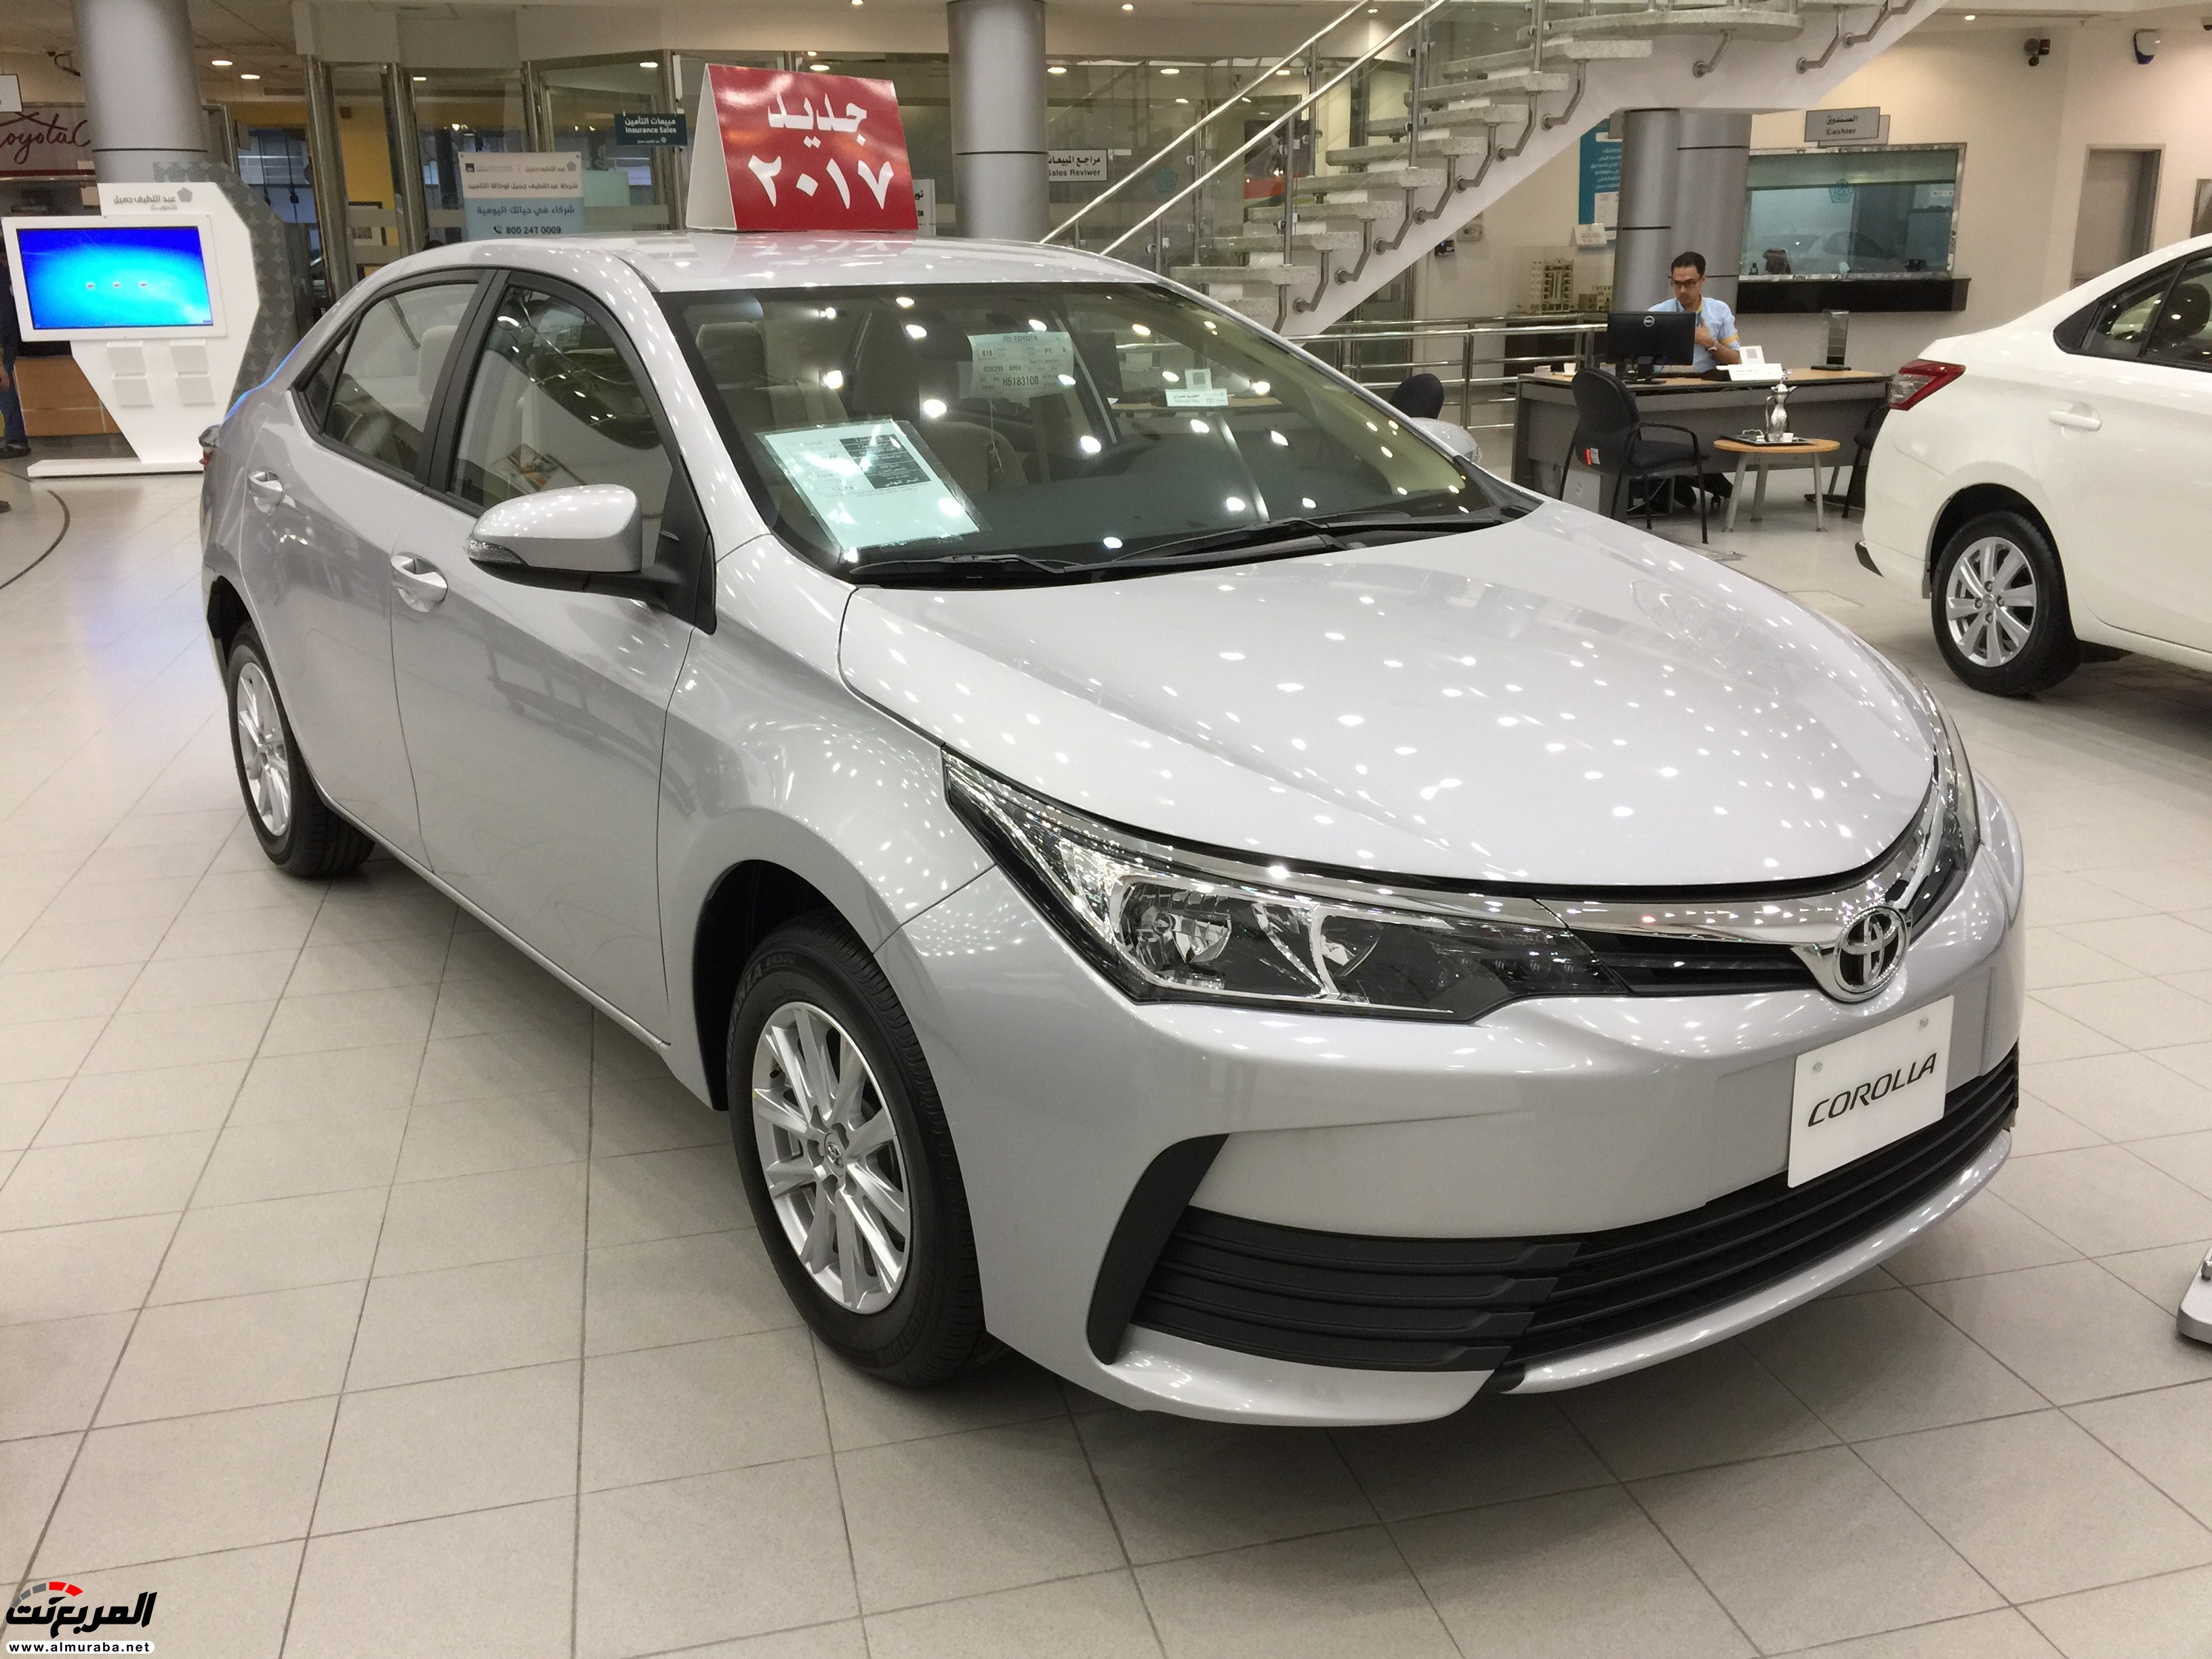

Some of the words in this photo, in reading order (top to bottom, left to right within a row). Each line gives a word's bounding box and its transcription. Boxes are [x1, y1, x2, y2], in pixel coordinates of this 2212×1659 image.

[651, 117, 676, 126] مبيعات
[768, 92, 867, 148] جديد
[1826, 115, 1858, 125] الصندوق
[1076, 156, 1101, 167] مراجع
[748, 155, 895, 209] ٢٠١٧
[114, 194, 132, 204] جميل
[134, 194, 161, 203] اللطيف
[476, 206, 507, 216] اليومية
[510, 206, 531, 216] حياتك
[534, 206, 548, 216] في
[552, 205, 575, 216] شركاء
[506, 226, 521, 234] 800
[541, 226, 561, 234] 0009
[1808, 1052, 1937, 1127] COROLLA
